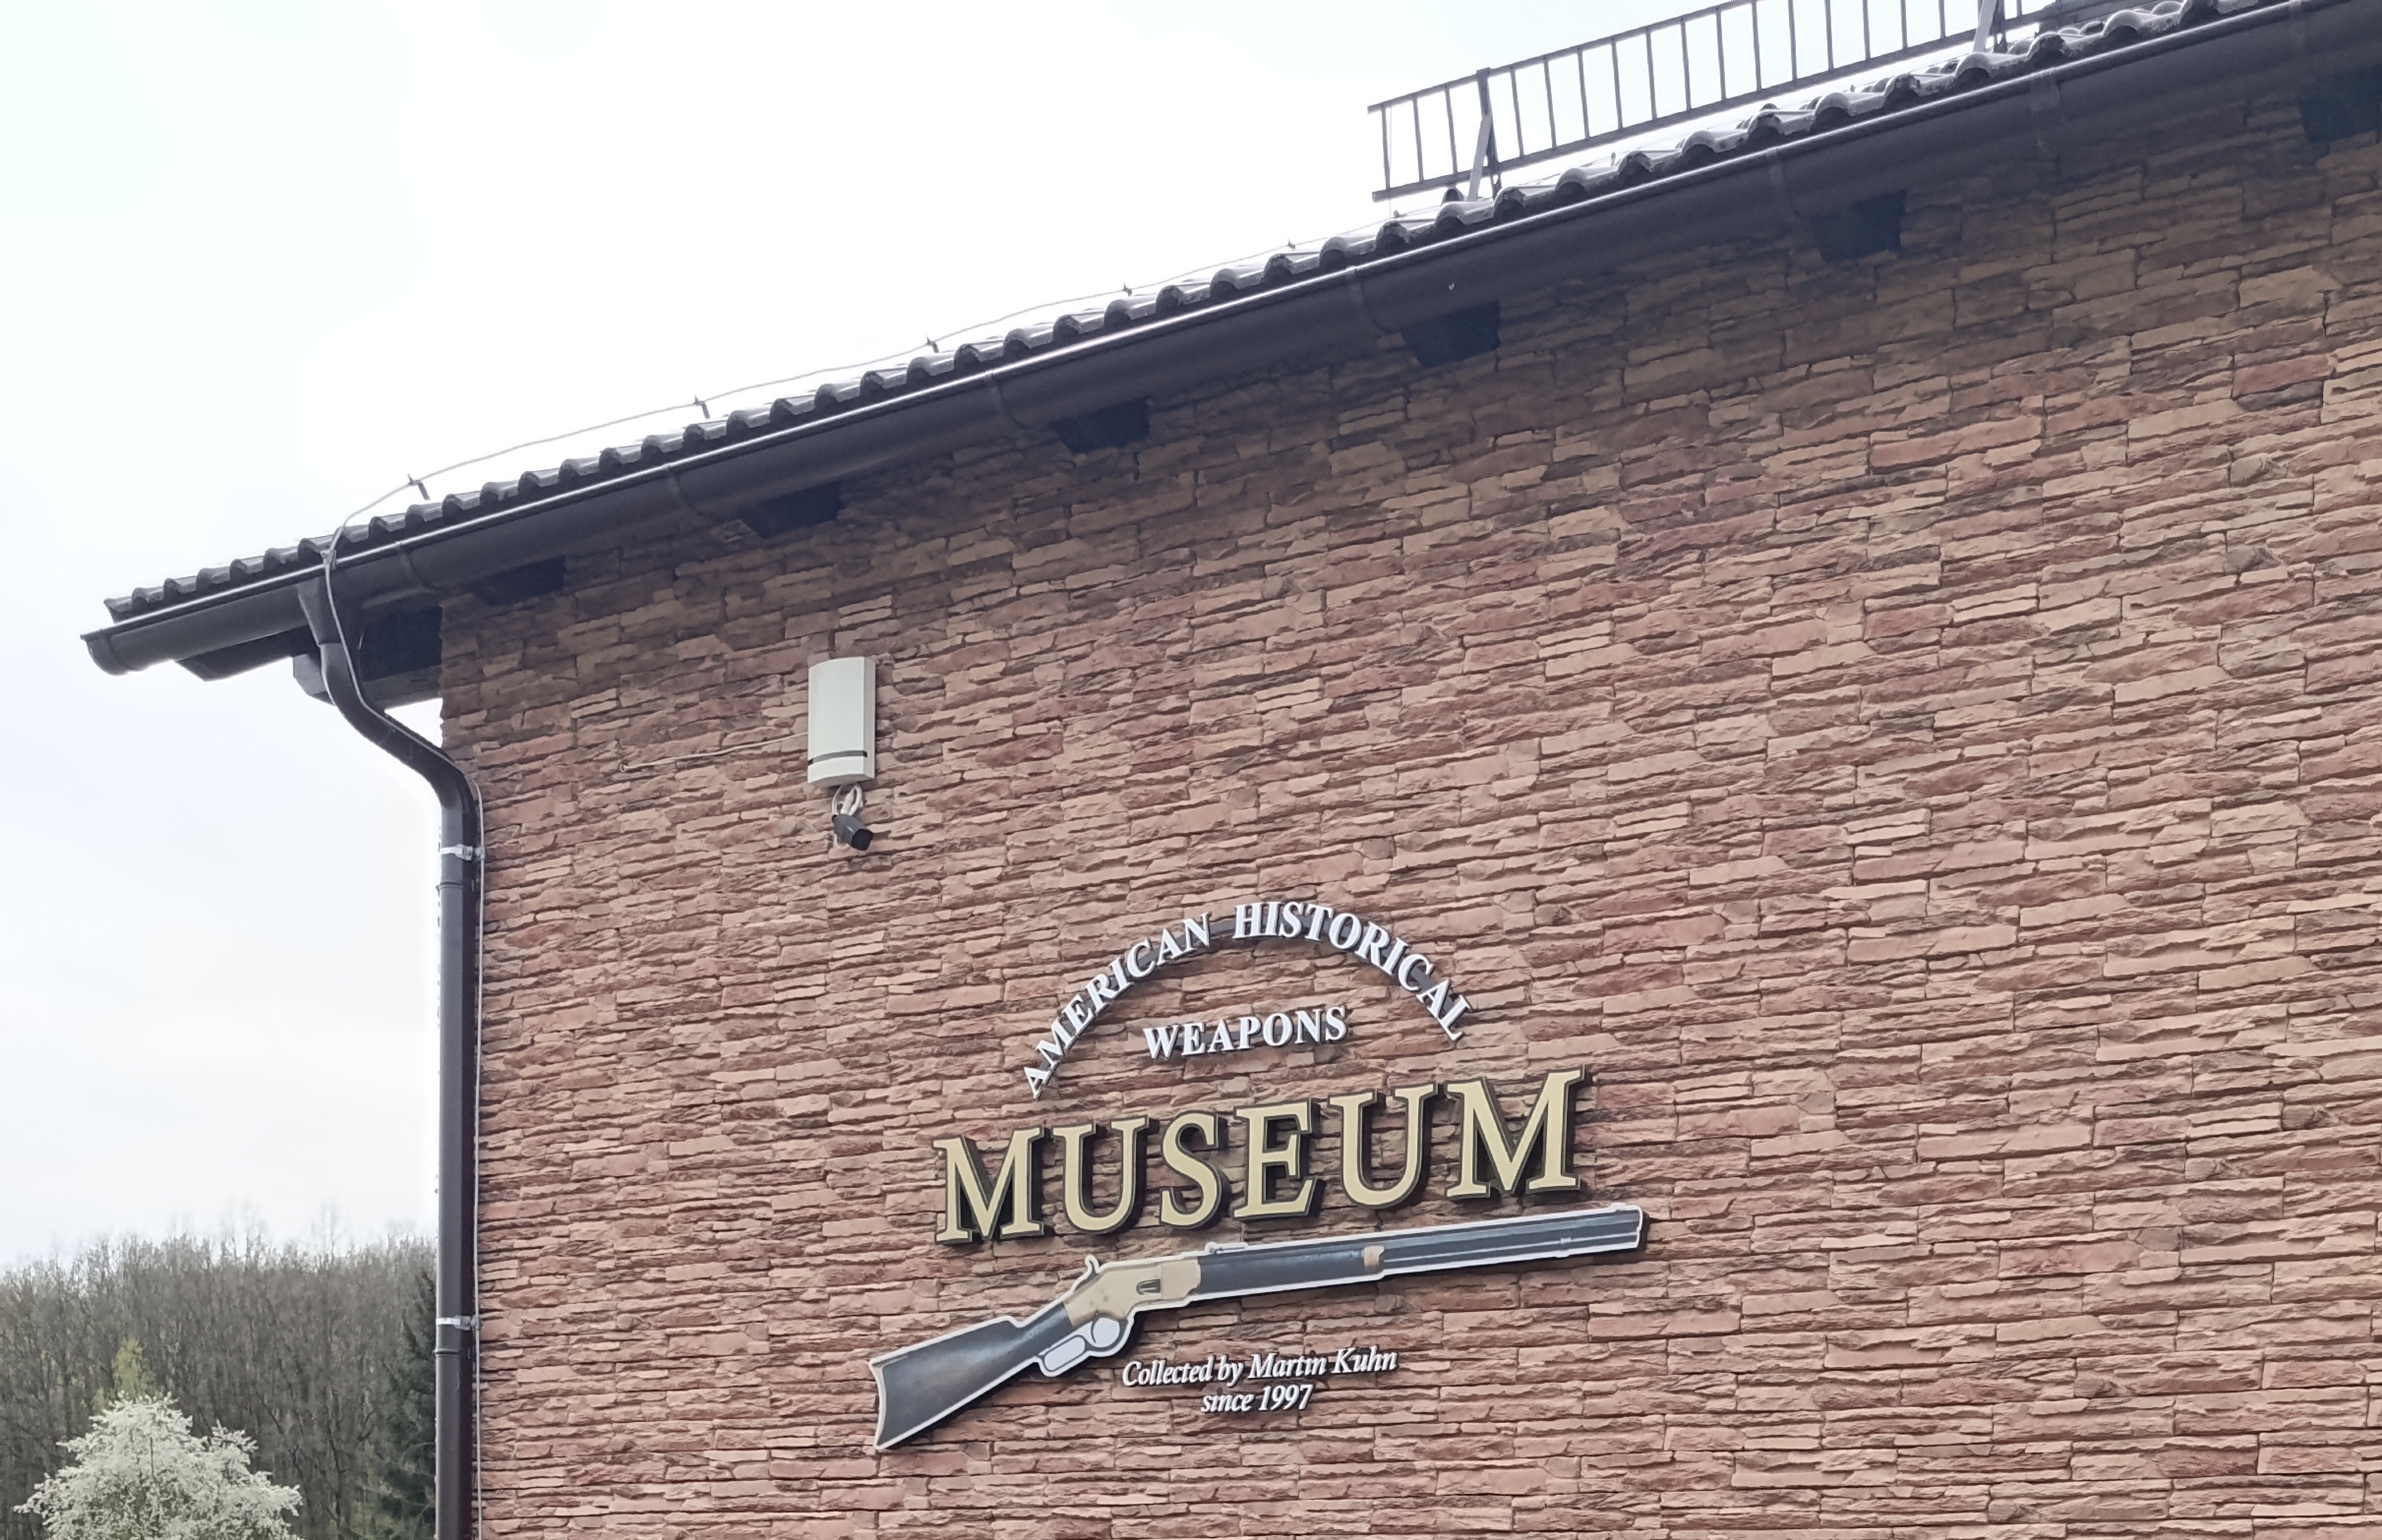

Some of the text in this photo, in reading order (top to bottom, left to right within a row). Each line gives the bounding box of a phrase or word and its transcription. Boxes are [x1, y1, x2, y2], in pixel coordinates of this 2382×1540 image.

[1023, 900, 1473, 1098] AMERICAN HISTORICAL
[1143, 1005, 1348, 1060] WEAPONS
[932, 1066, 1586, 1244] MUSEUM
[1121, 1344, 1399, 1388] Collected by Martin Kuhn
[1200, 1384, 1314, 1413] since 1997
